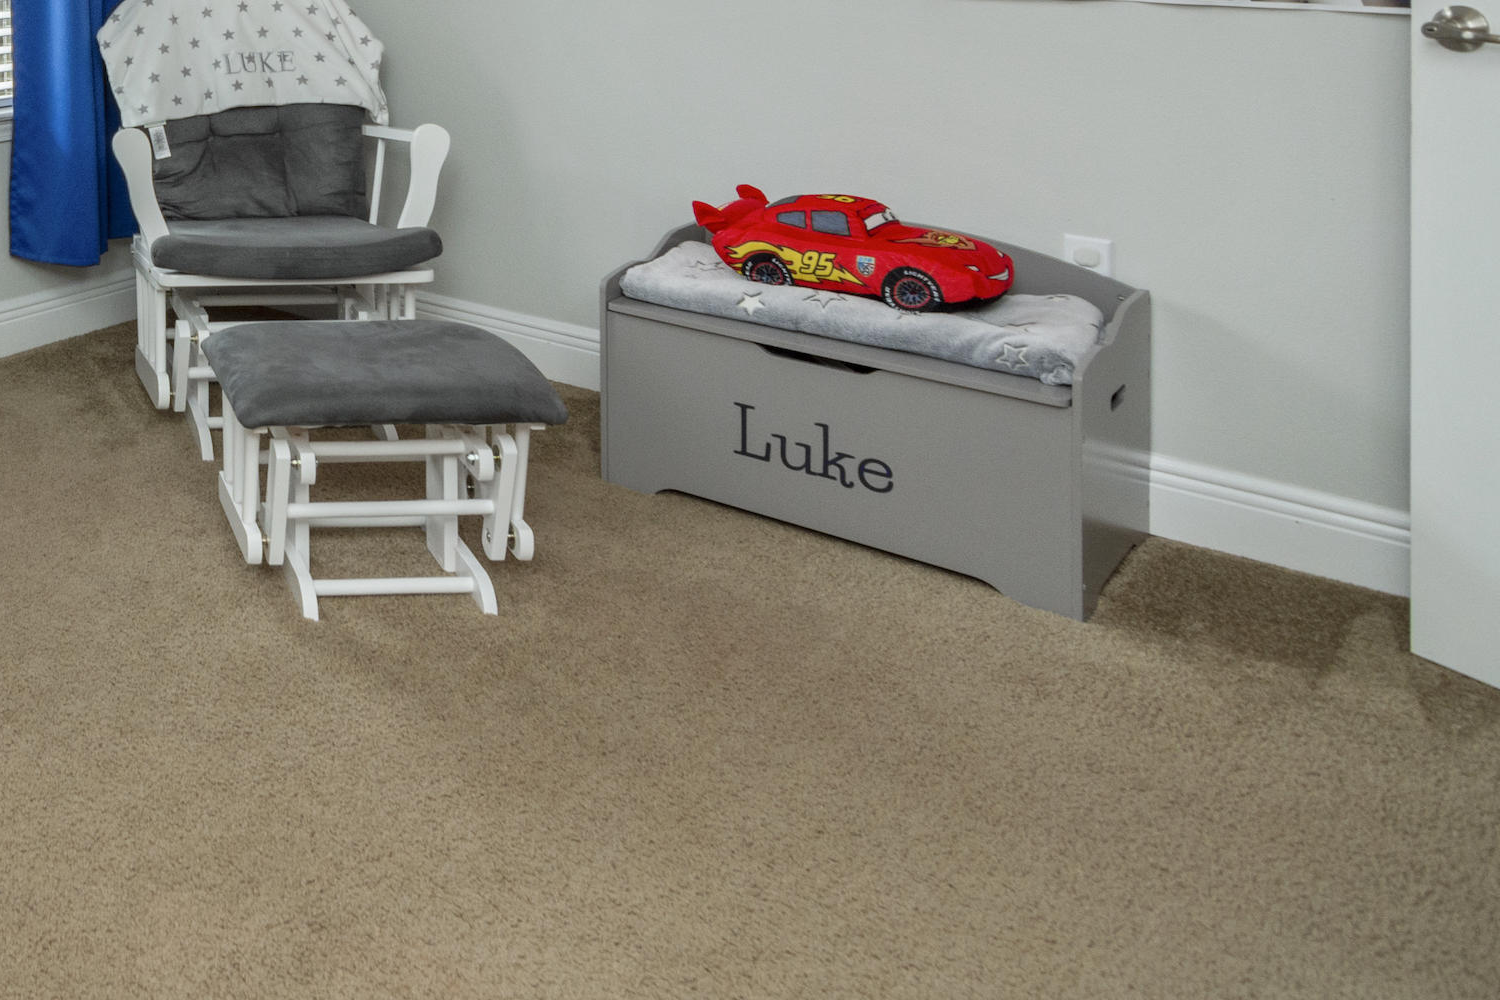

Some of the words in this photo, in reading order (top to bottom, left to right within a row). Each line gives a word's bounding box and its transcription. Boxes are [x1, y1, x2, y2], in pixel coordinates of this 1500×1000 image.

[222, 50, 297, 75] LUKE
[799, 250, 837, 277] 95
[733, 402, 895, 494] Luke
